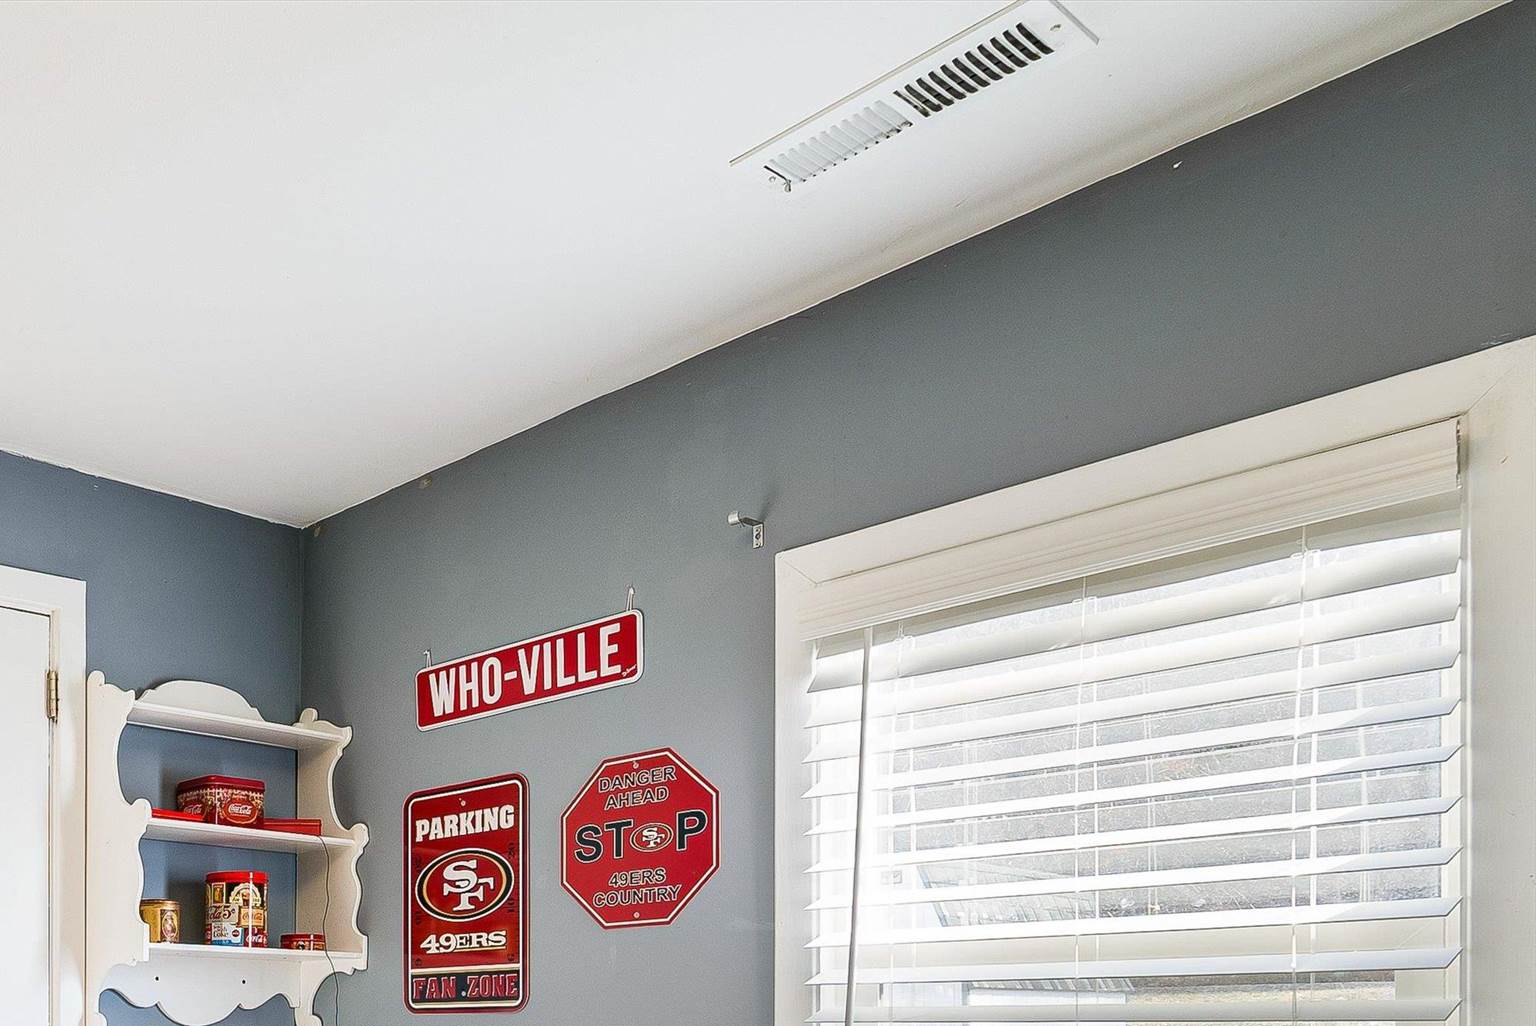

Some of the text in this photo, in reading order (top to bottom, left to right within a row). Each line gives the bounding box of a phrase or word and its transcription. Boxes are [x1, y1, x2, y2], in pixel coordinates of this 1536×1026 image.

[429, 623, 622, 717] WHO-VILLE
[599, 765, 677, 792] DANGER
[604, 787, 669, 810] AHEAD
[415, 805, 515, 843] PARKING
[609, 868, 666, 887] 49ERS
[593, 885, 682, 907] COUNTRY
[420, 930, 507, 954] 49ERS
[413, 974, 518, 1000] FAN ZONE
